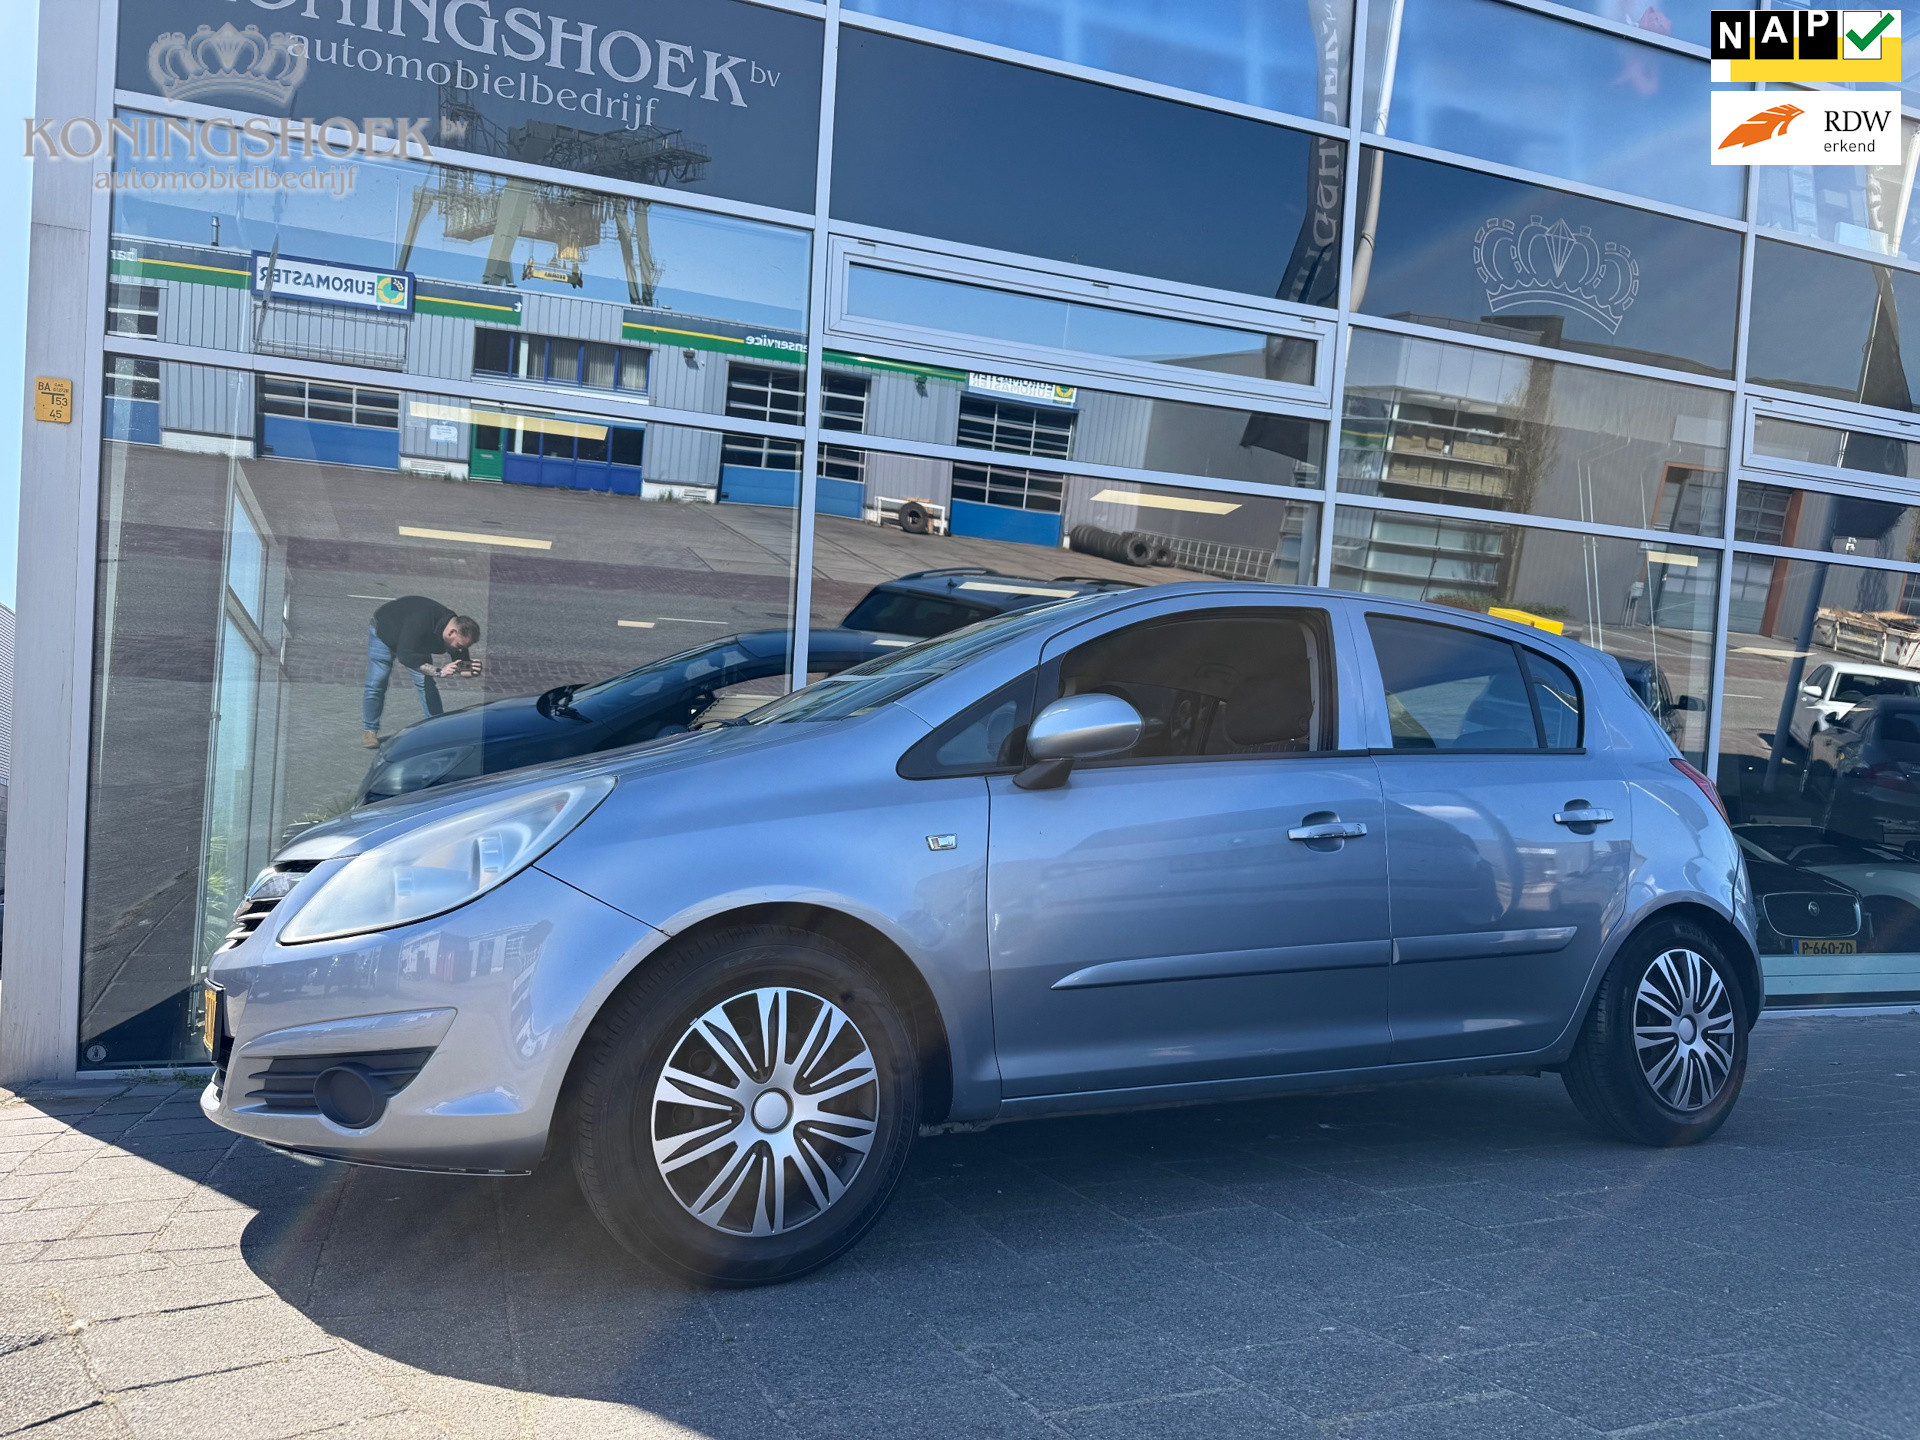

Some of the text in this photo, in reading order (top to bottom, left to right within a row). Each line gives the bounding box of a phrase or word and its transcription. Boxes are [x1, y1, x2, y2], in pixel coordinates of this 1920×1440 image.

[750, 61, 781, 87] bv
[287, 34, 659, 131] automobielbedrijf
[38, 381, 51, 391] BA
[55, 397, 68, 407] 53
[49, 409, 62, 419] 45
[1801, 942, 1853, 955] P-660-ZD
